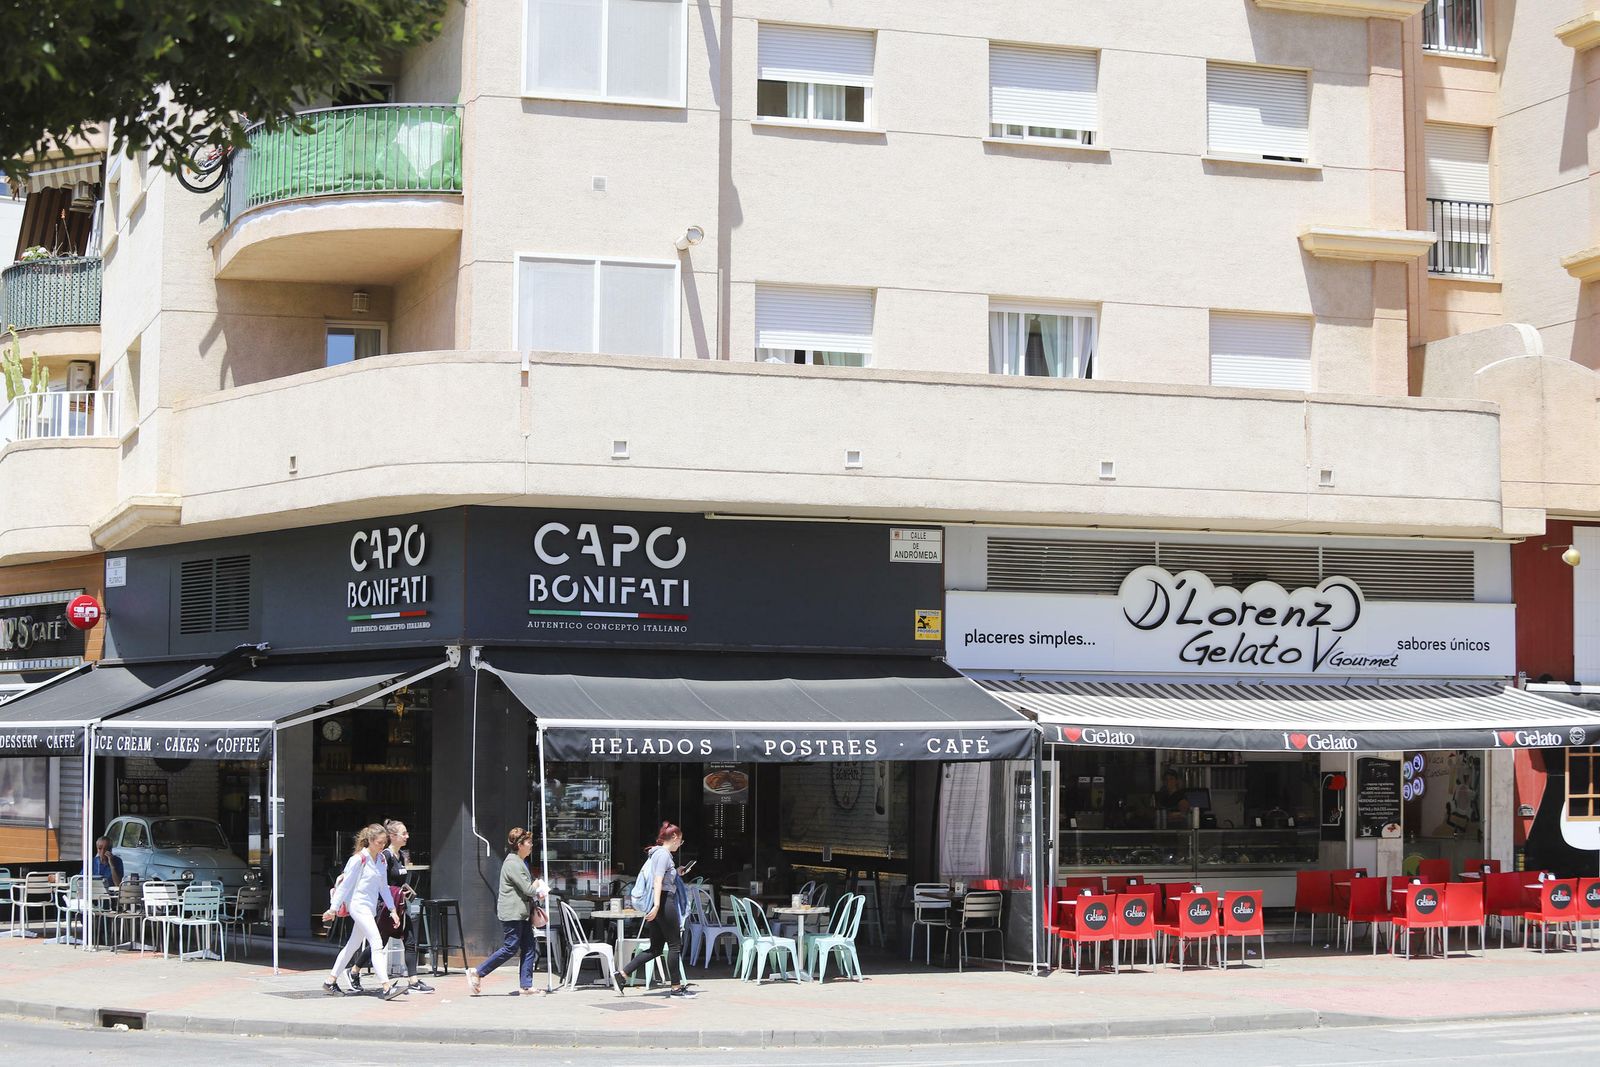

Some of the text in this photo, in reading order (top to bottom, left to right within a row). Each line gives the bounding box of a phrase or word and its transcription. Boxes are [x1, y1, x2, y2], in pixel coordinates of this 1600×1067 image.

[910, 531, 927, 540] CALLE
[350, 524, 426, 572] CAPO
[534, 522, 687, 569] CAPO
[347, 575, 427, 608] BONIFATI
[529, 574, 690, 607] BONIFATI
[32, 615, 61, 641] CAFÉ
[527, 621, 688, 633] AUTENTICO CONCEPTO ITALIANO
[964, 628, 1096, 648] placeres simples...
[1397, 636, 1490, 652] sabores únicos
[1178, 630, 1302, 666] Gelato
[1329, 651, 1399, 668] Gourmet
[0, 735, 37, 748] DESSERT
[95, 735, 260, 753] ICE CREAM CAKES COFFEE
[1055, 725, 1136, 745] I Gelato
[1282, 732, 1358, 750] I Gelato
[1492, 730, 1501, 747] I
[1515, 730, 1562, 746] Gelato
[590, 736, 990, 755] HELADOS POSTRES CAFÉ
